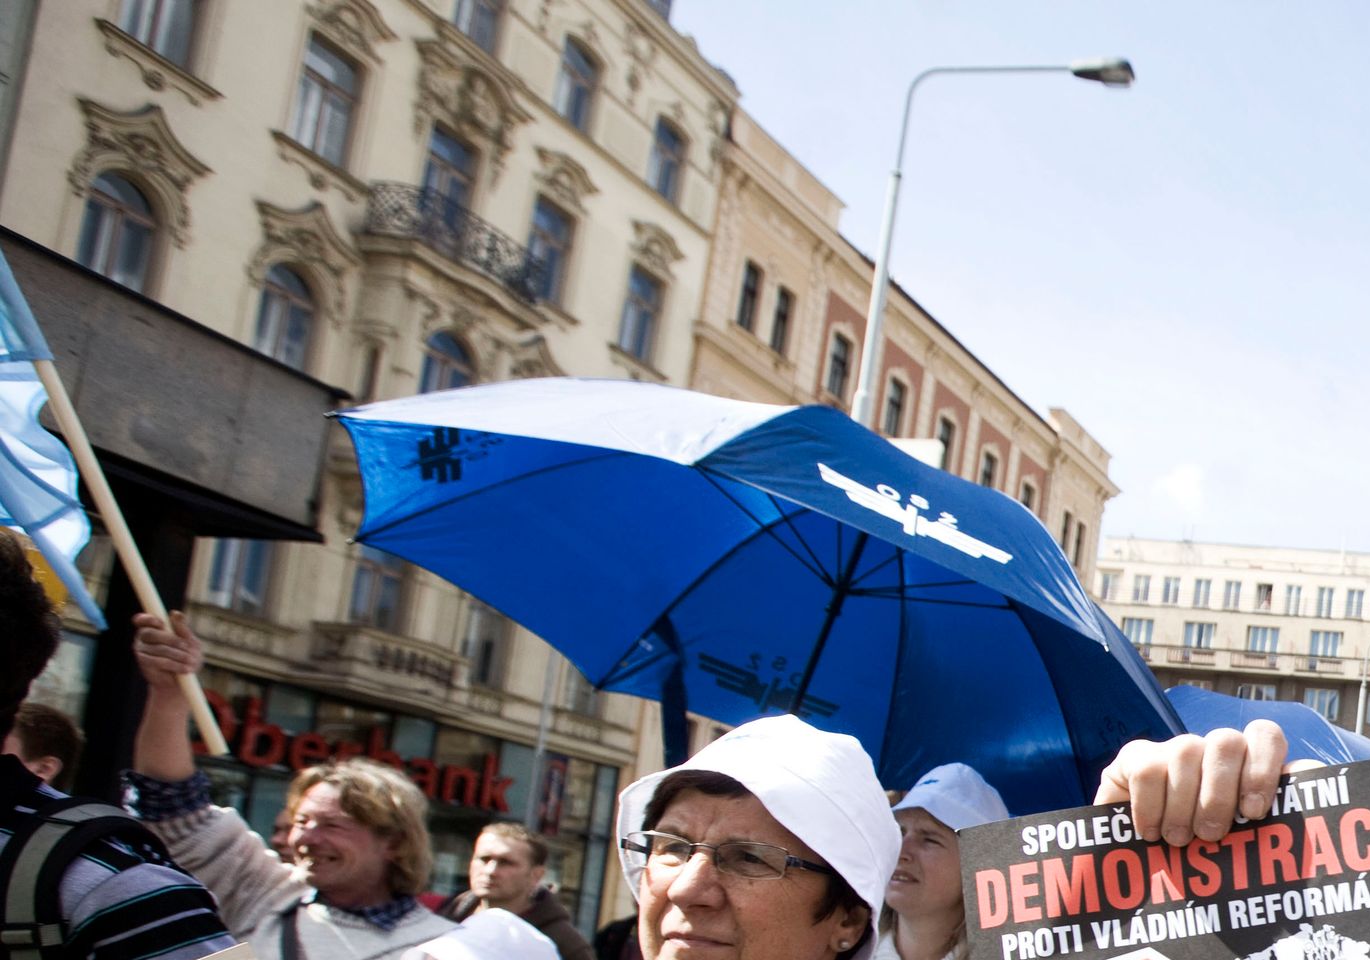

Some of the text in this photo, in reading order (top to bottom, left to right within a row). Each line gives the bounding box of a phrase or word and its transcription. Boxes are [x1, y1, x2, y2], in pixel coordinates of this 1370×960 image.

[1021, 767, 1350, 856] SPOLEČ TÁTNÍ
[1091, 902, 1221, 948] VLÁDNÍM
